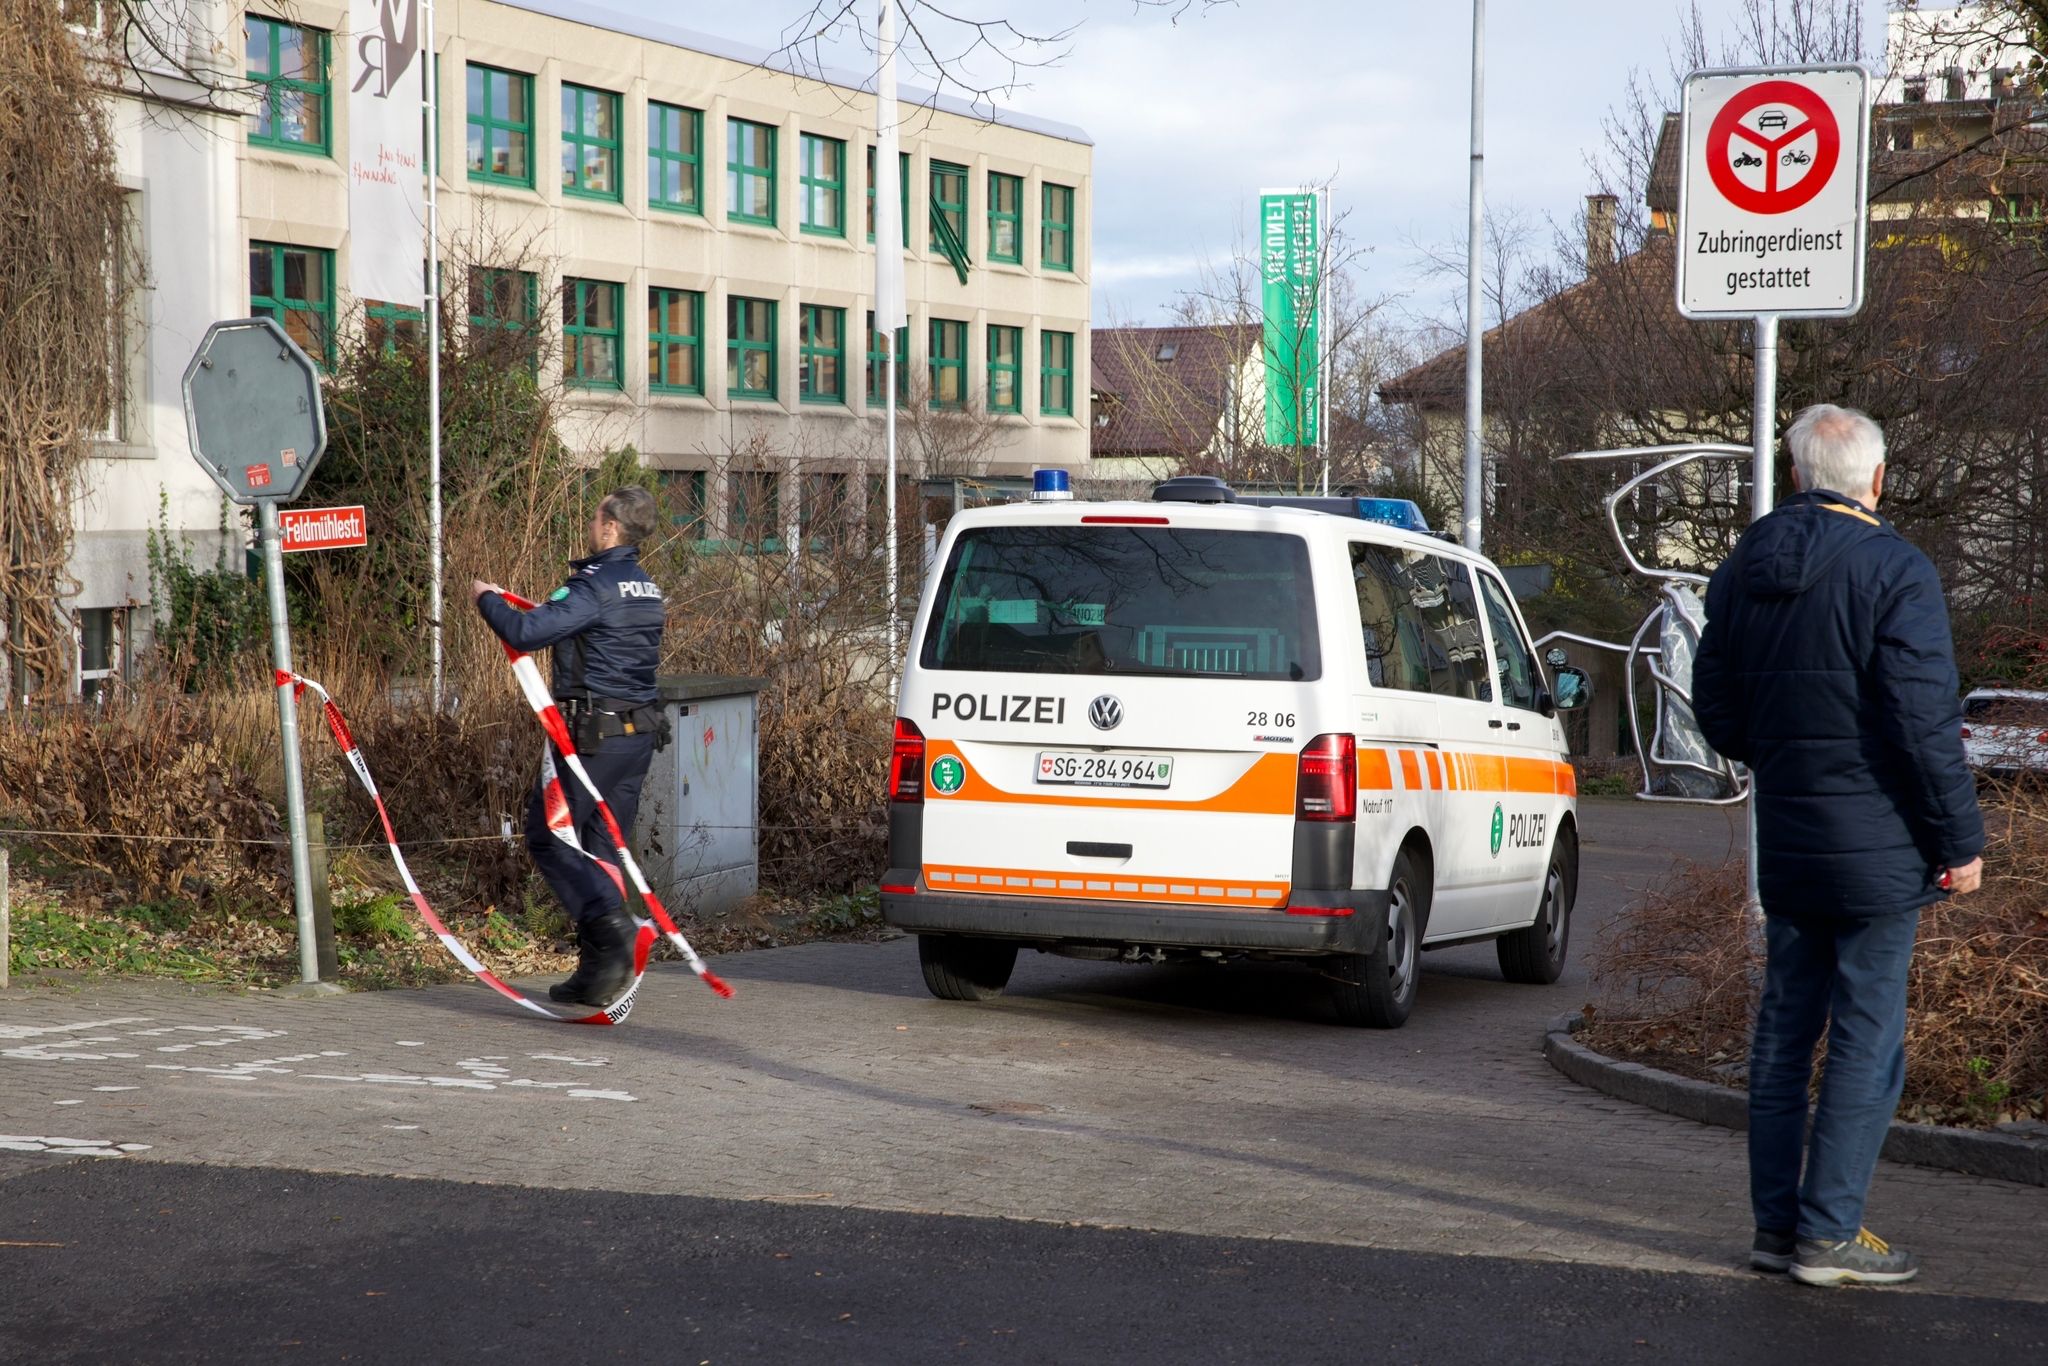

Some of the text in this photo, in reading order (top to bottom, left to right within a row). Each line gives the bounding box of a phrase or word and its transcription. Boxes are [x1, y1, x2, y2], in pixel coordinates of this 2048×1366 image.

[1698, 228, 1843, 258] Zubringerdienst
[1726, 267, 1810, 295] gestattet
[285, 512, 362, 543] Feldmühlestr.
[617, 581, 662, 599] POLIZE
[932, 693, 1065, 724] POLIZEI
[1090, 696, 1123, 730] VW
[1247, 711, 1295, 728] 28 06
[1363, 798, 1393, 813] Notruf 117
[1508, 812, 1547, 848] POLIZEI
